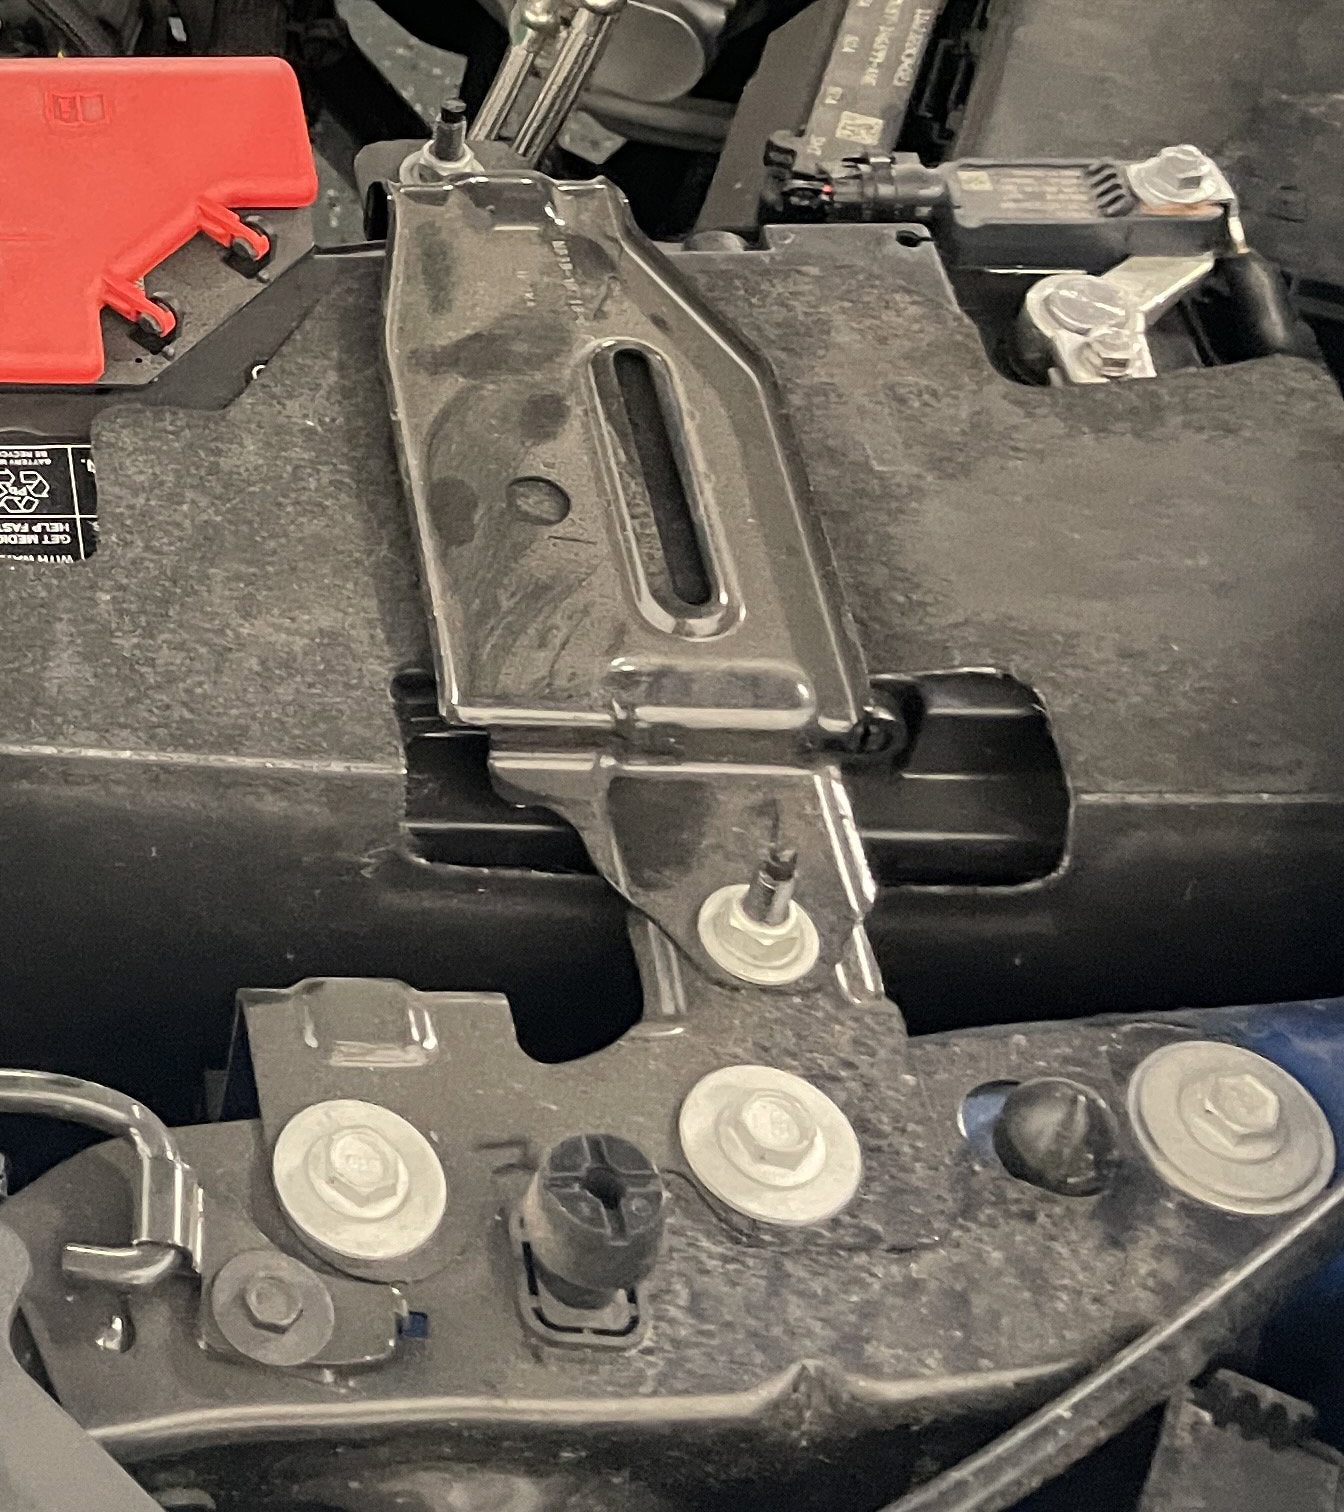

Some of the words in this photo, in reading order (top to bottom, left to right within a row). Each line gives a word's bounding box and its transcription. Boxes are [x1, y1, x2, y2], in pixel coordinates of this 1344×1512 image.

[9, 458, 52, 466] BATTERY
[31, 522, 70, 533] HELP
[41, 534, 72, 545] GET
